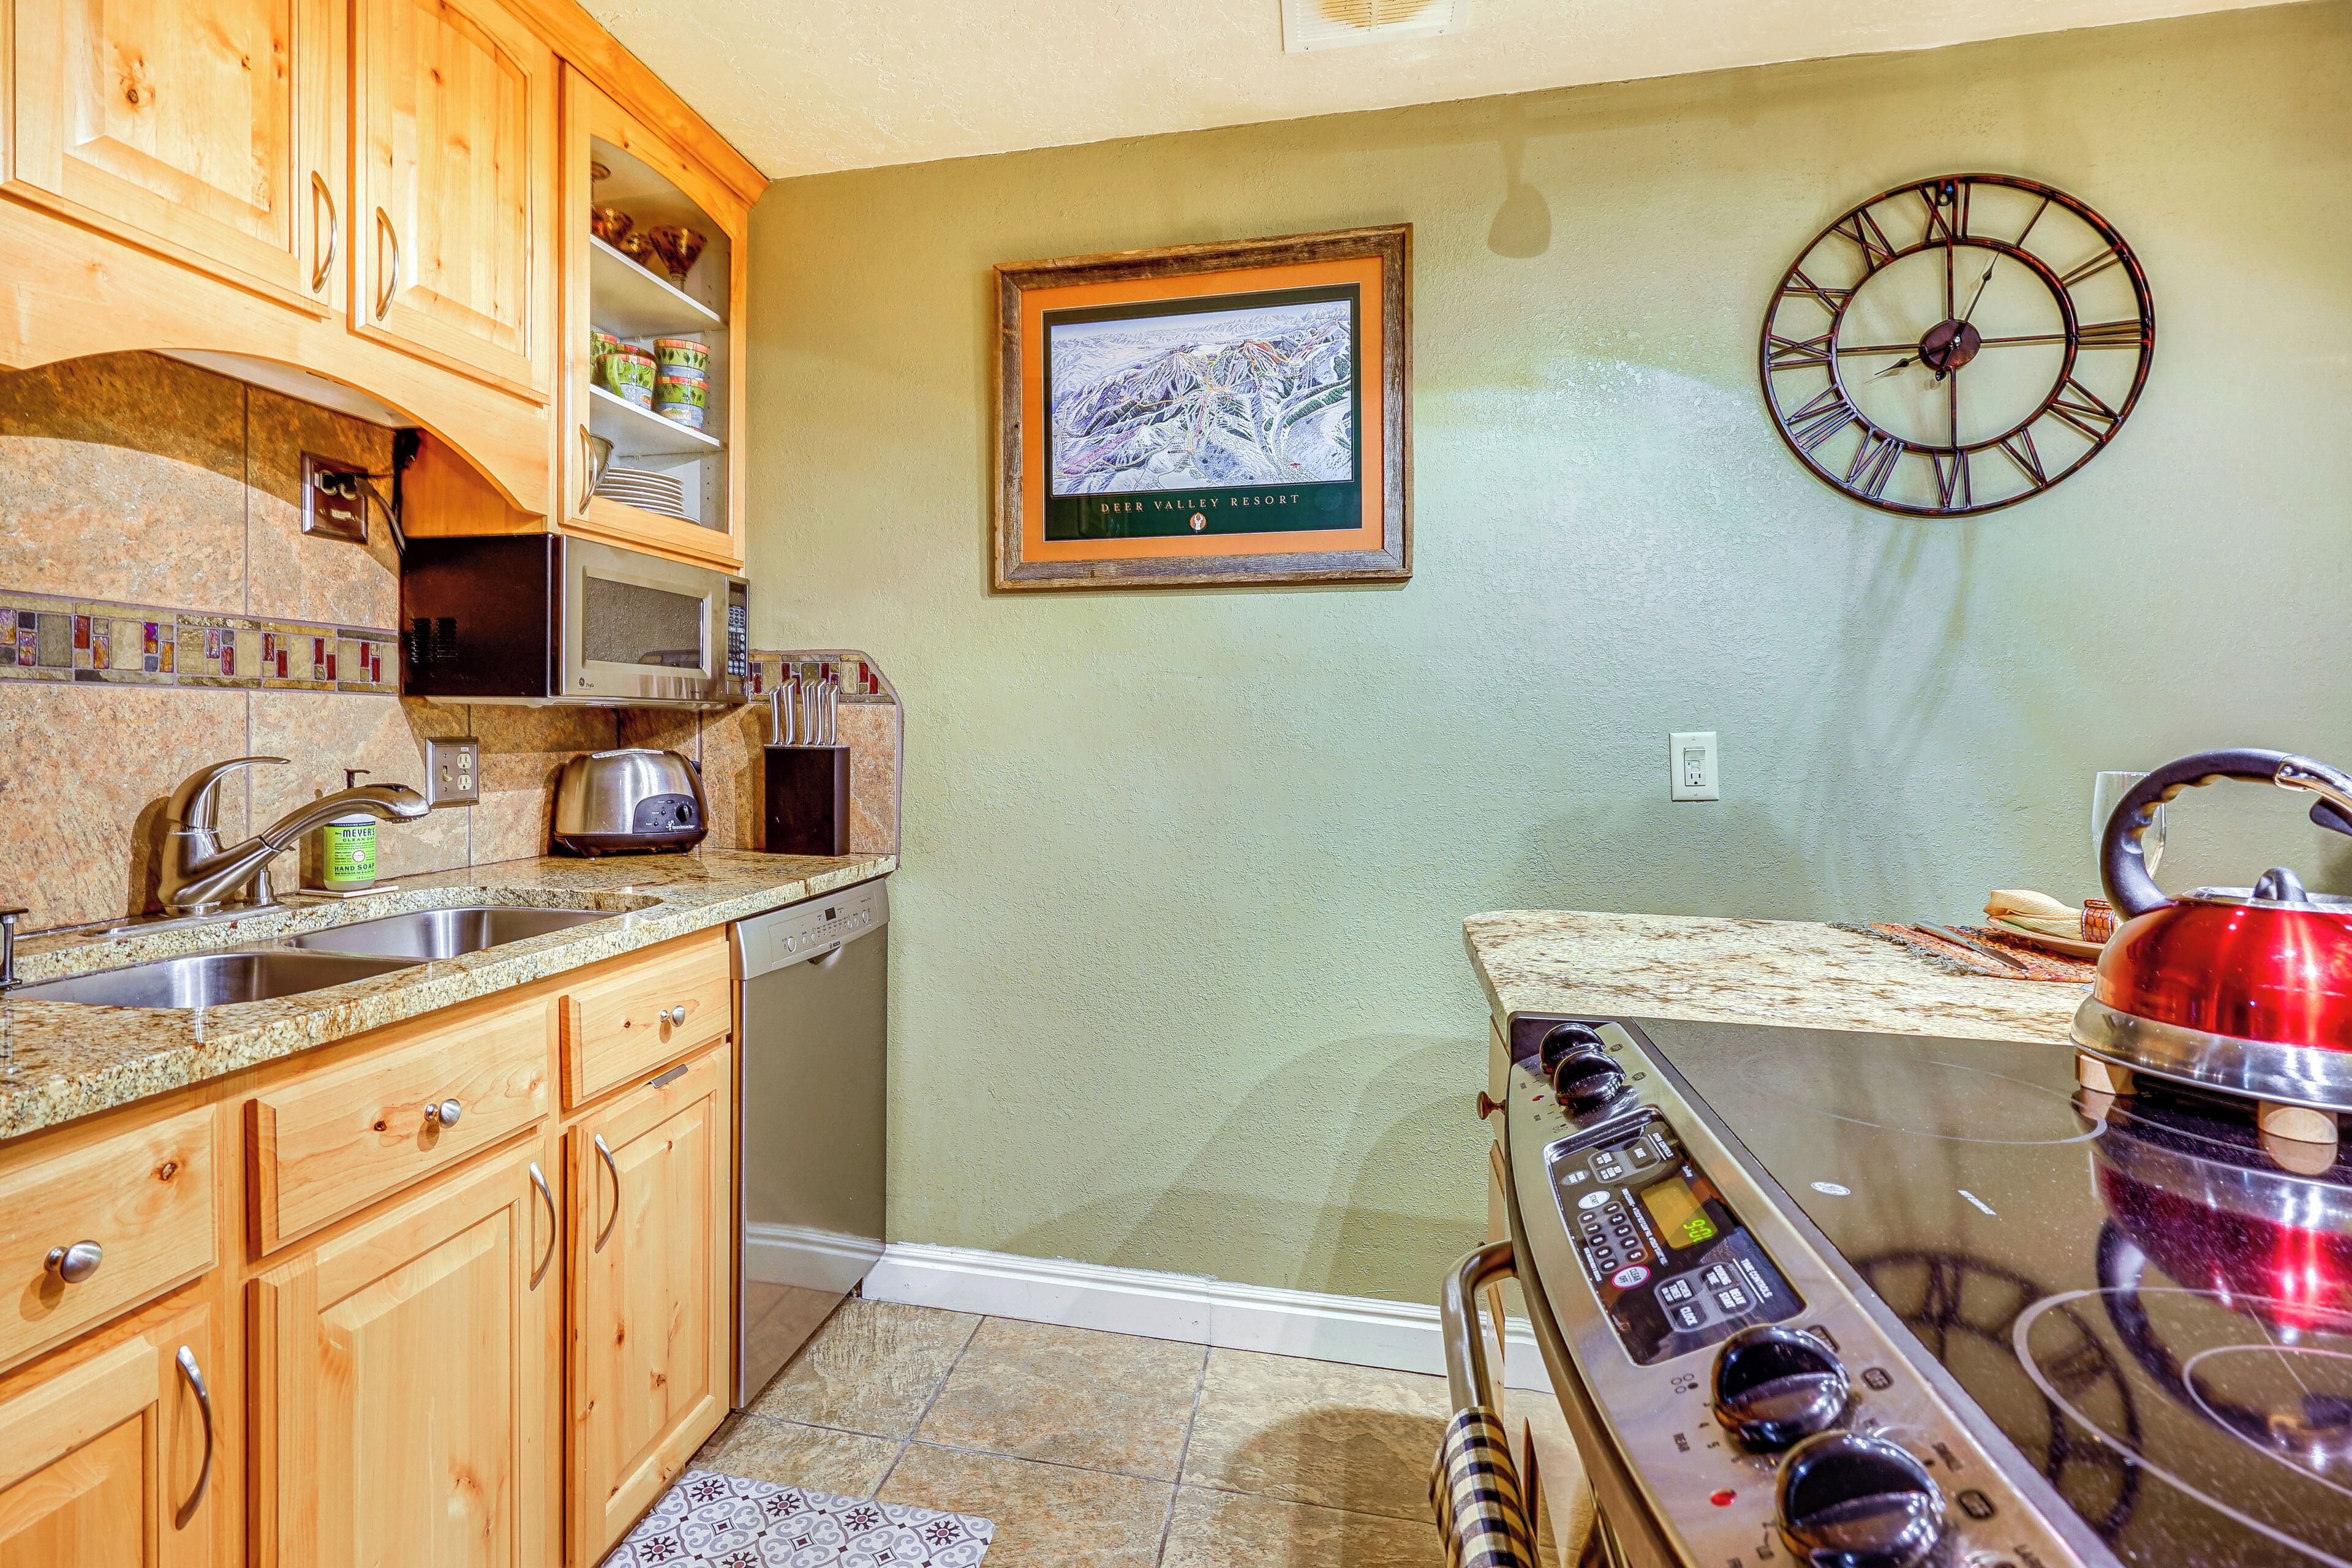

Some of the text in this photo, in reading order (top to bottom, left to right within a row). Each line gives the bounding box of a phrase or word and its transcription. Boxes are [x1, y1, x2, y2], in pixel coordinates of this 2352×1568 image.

[1101, 494, 1300, 513] DEER VALLEY RESORT
[1634, 1147, 1646, 1159] BAKE
[1653, 1133, 1674, 1158] OVEN CONTROLS
[1589, 1195, 1599, 1205] START
[1629, 1268, 1642, 1281] CLEAR
[1706, 1271, 1721, 1285] TIME
[1713, 1265, 1732, 1286] COOKING
[1741, 1258, 1773, 1298] TIME CONTROLS
[1719, 1292, 1736, 1309] START
[1728, 1288, 1747, 1305] DELAY
[1679, 1306, 1698, 1326] CLOCK
[1673, 1432, 1691, 1453] REAR
[1706, 1441, 1720, 1449] 5
